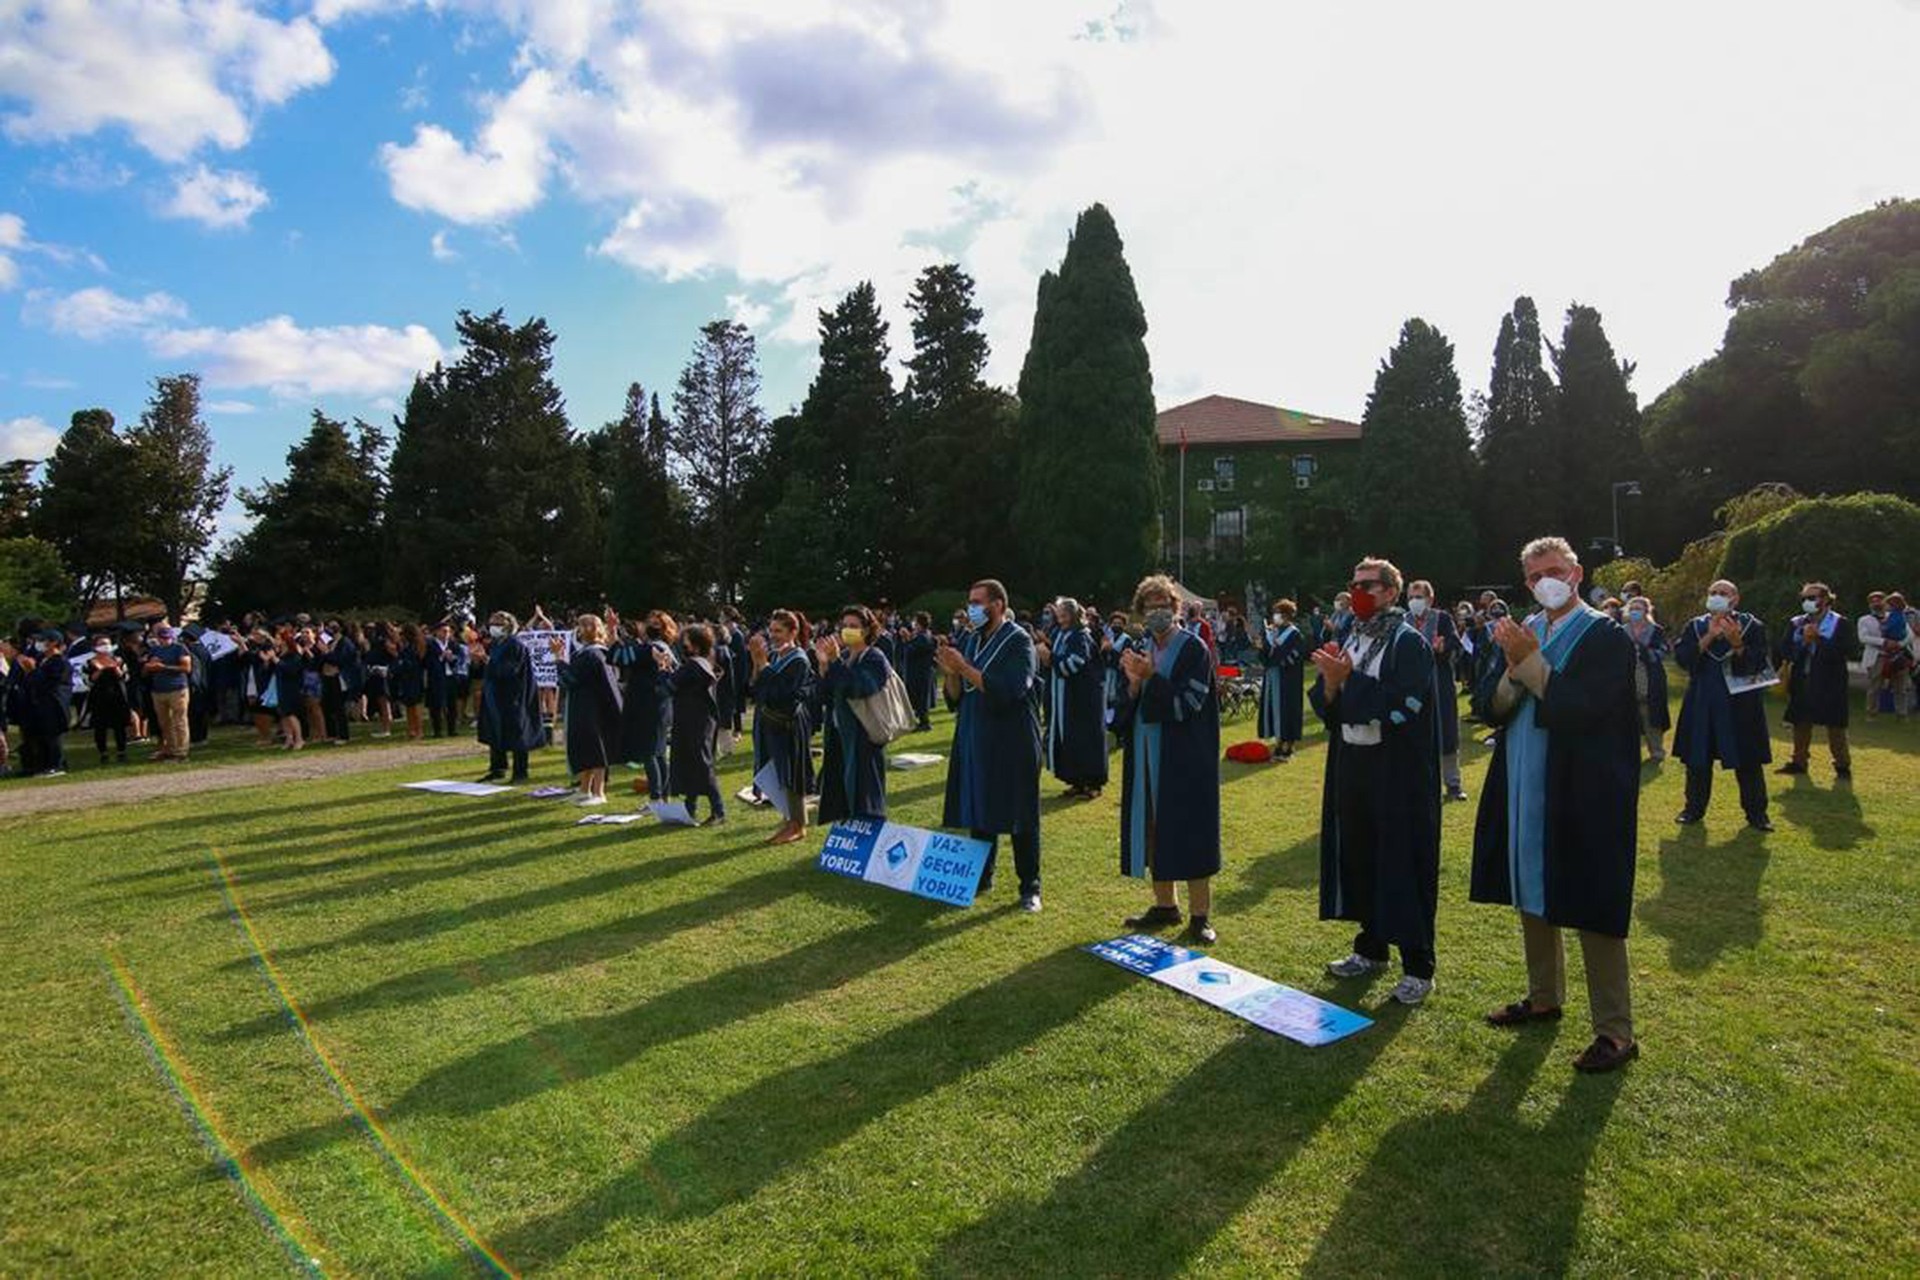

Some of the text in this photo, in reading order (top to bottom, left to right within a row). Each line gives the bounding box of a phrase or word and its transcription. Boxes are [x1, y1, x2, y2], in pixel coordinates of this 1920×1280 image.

[826, 835, 859, 851] ETMİ-
[932, 835, 965, 852] VAZ-
[820, 852, 863, 875] YORUZ.
[922, 855, 976, 878] GEÇMİ-
[917, 876, 970, 903] YORUZ.
